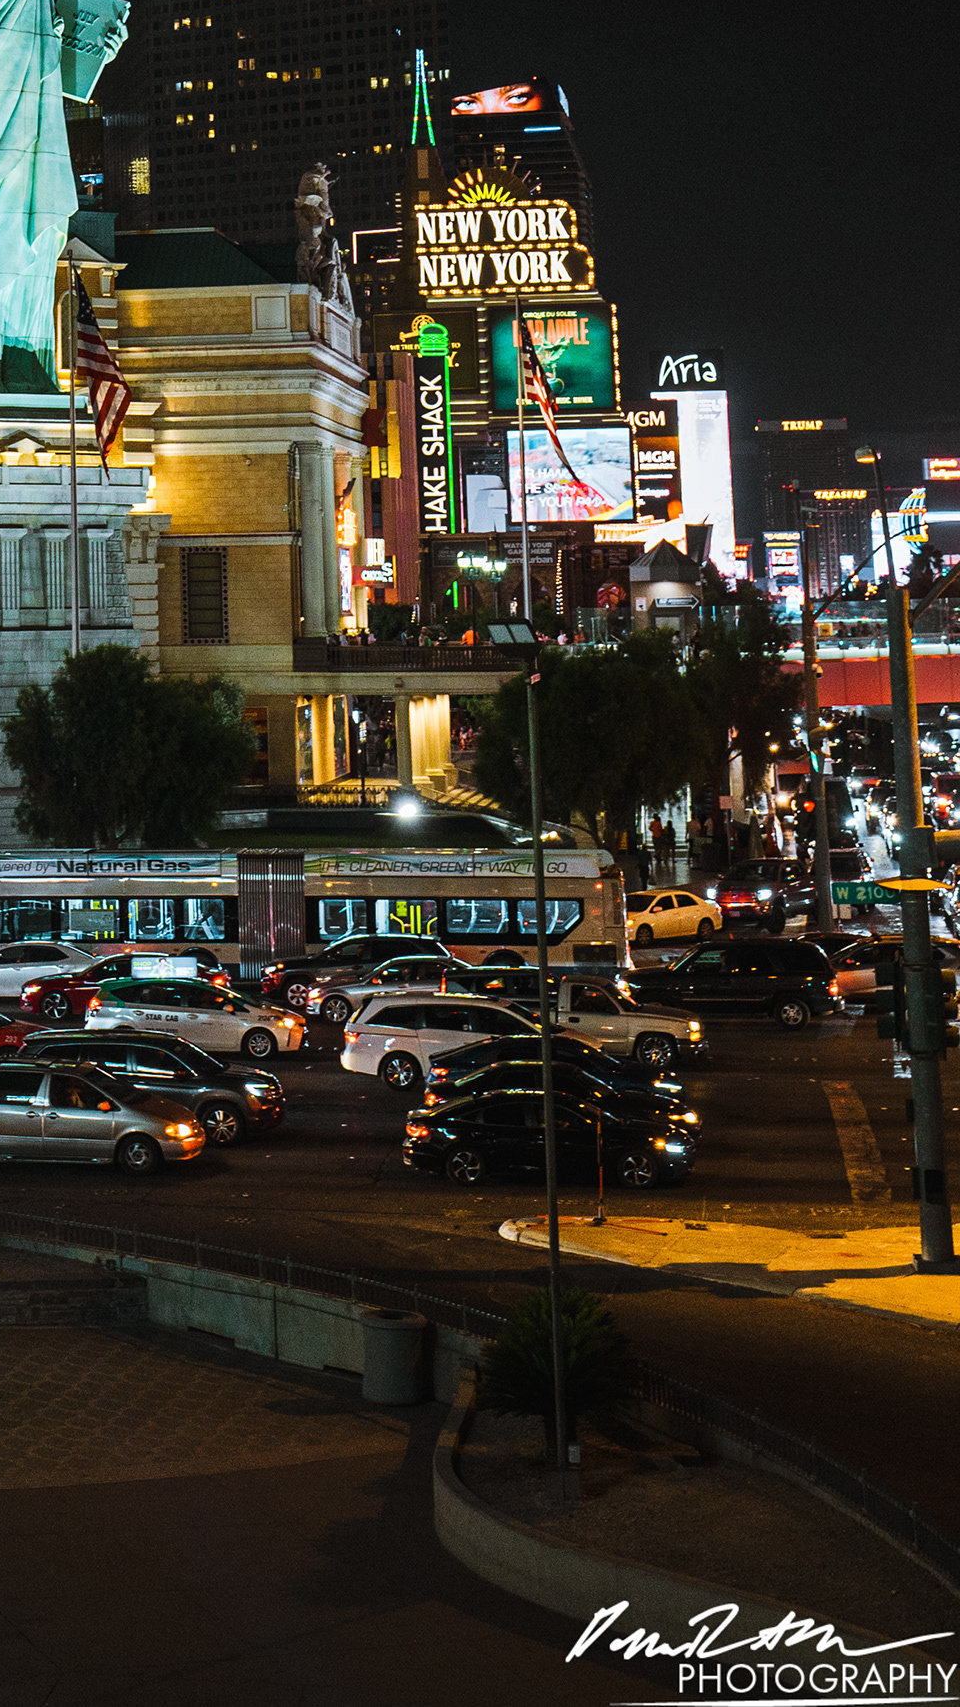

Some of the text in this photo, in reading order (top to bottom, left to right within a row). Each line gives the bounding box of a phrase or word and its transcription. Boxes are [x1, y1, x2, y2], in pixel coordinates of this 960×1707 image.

[416, 207, 570, 245] NEW YORK
[417, 250, 573, 287] NEW YORK
[522, 311, 546, 319] CIRQUE
[546, 317, 590, 346] APPLE
[658, 354, 718, 387] Aria
[419, 374, 445, 456] SHACK
[781, 420, 823, 431] TRUMP
[638, 450, 676, 463] MGM
[422, 465, 448, 535] HAKE
[538, 495, 573, 508] YOUR
[813, 489, 868, 501] TREASURE
[36, 860, 50, 875] by
[56, 858, 141, 873] Natural
[147, 858, 191, 873] Gas
[320, 861, 345, 872] THE
[349, 861, 413, 874] CLEANER,
[419, 861, 483, 873] GREENER
[489, 861, 521, 873] WAY
[546, 862, 569, 874] GO.
[836, 887, 849, 900] W
[145, 1013, 179, 1022] STAR CAB
